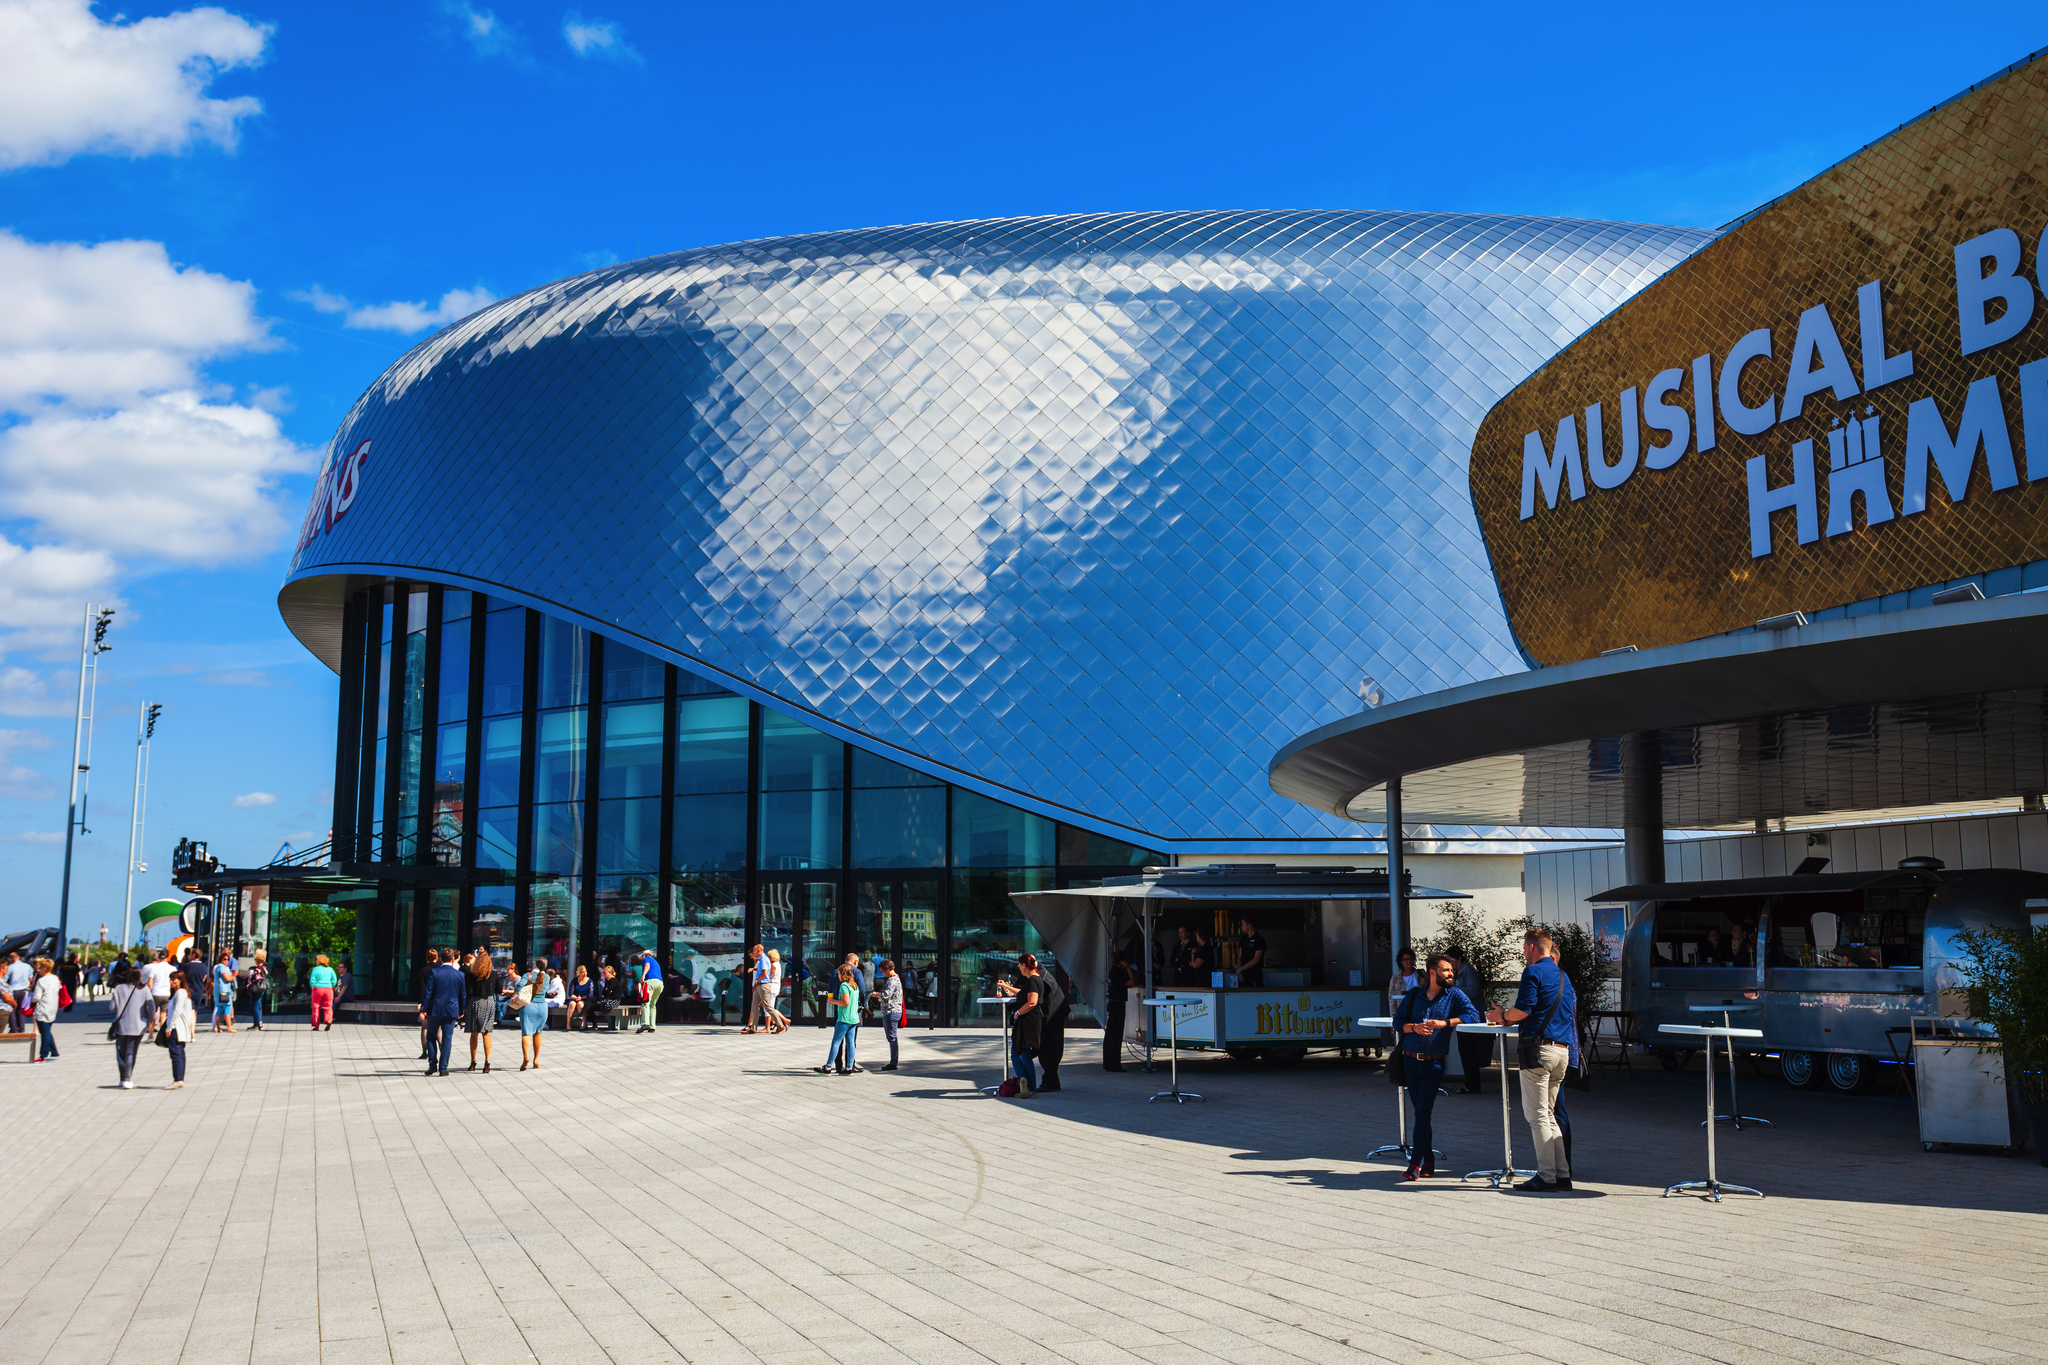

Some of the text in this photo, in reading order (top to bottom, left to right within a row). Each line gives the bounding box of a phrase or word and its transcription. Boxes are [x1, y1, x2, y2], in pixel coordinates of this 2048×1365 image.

[1519, 222, 2048, 521] MUSICAL B
[1162, 1009, 1180, 1023] Bie
[1193, 1003, 1208, 1015] Bit
[1254, 1002, 1353, 1039] Bitburger
